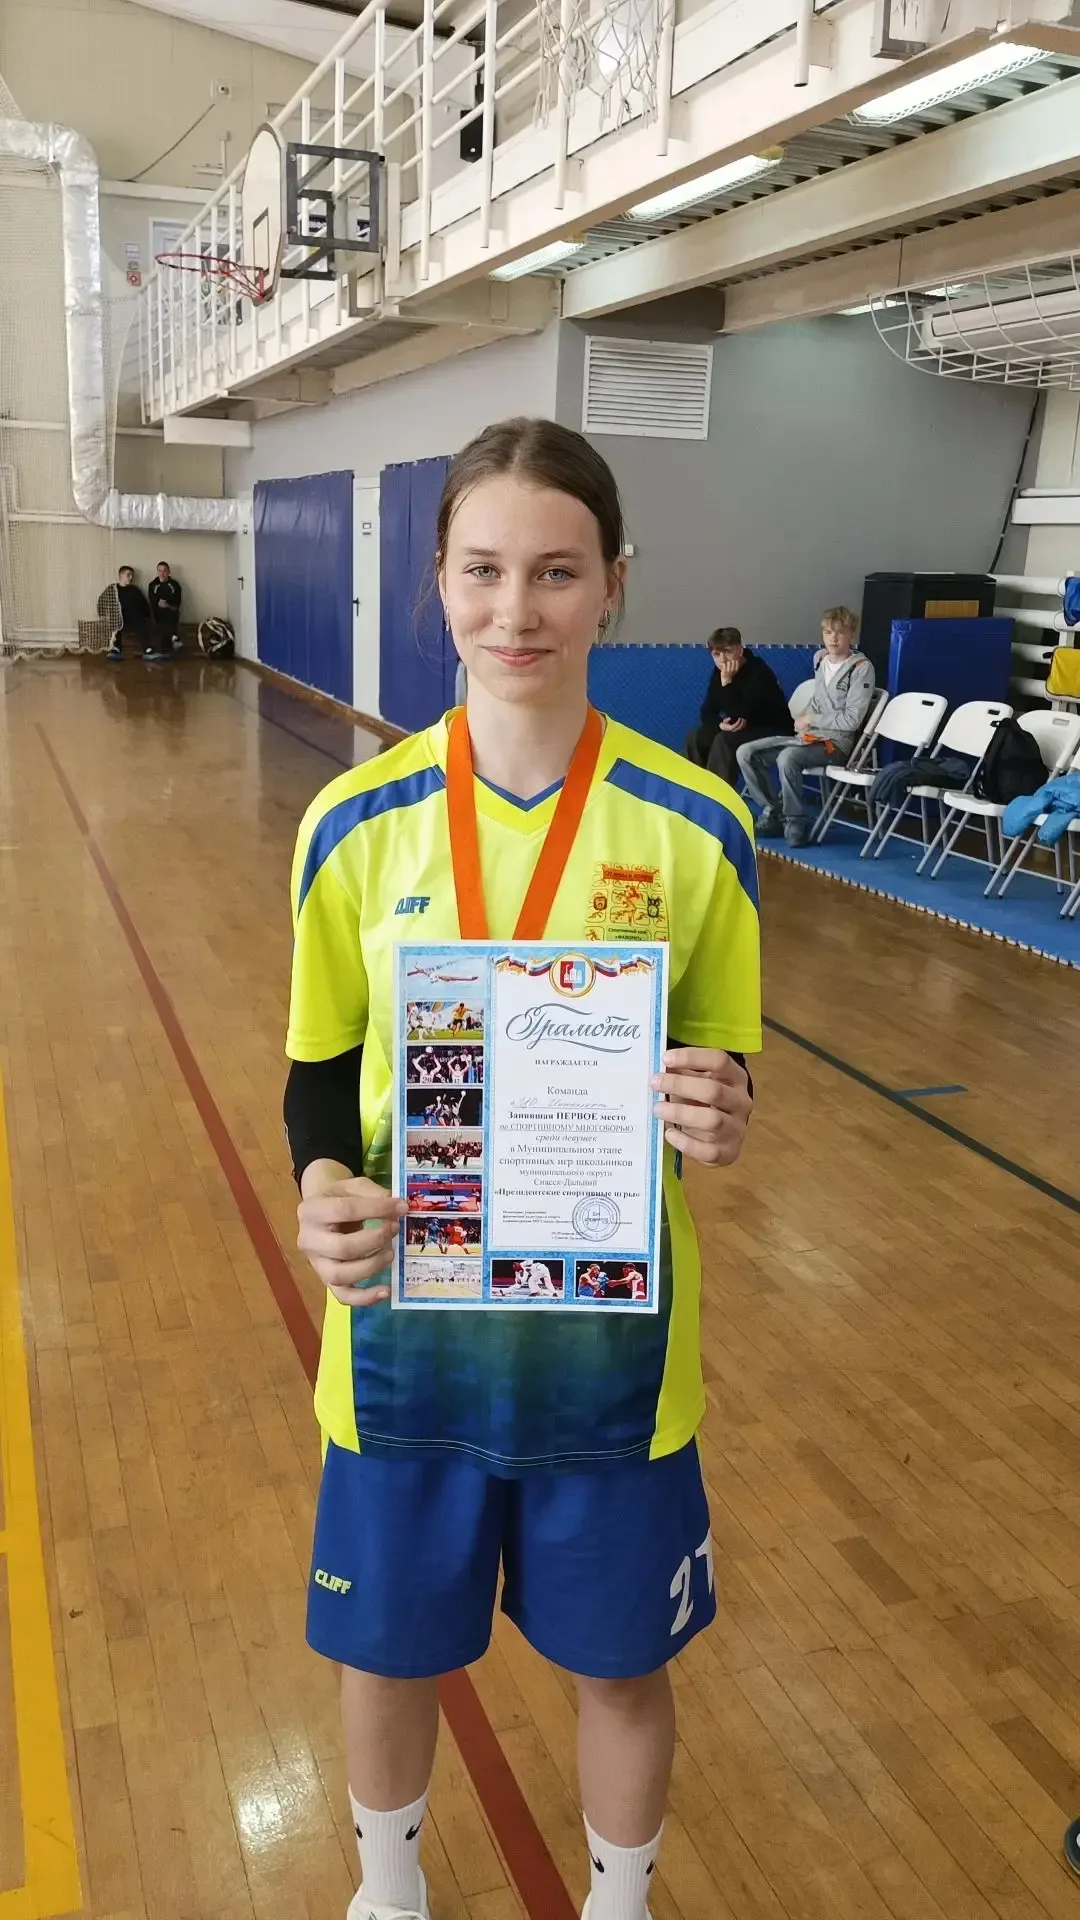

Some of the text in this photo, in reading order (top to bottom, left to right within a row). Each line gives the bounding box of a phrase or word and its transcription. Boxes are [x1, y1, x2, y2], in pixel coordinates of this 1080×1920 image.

[505, 1002, 641, 1053] Грамота
[535, 1059, 598, 1067] НАГРАЖДАЕТСЯ
[547, 1086, 588, 1096] Команда
[508, 1111, 554, 1120] Занявшая
[556, 1112, 598, 1121] ПЕРВОЕ
[510, 1123, 574, 1132] СПОРТИВНОМУ
[535, 1134, 597, 1143] среди девушек
[517, 1144, 595, 1155] Муниципальном
[598, 1147, 623, 1155] этапе
[499, 1157, 633, 1167] спортивных игр школьников
[519, 1169, 585, 1177] муниципального
[533, 1178, 598, 1187] Спасск-Дальний
[494, 1188, 561, 1197] «Президентские
[315, 1569, 352, 1594] CLIFF
